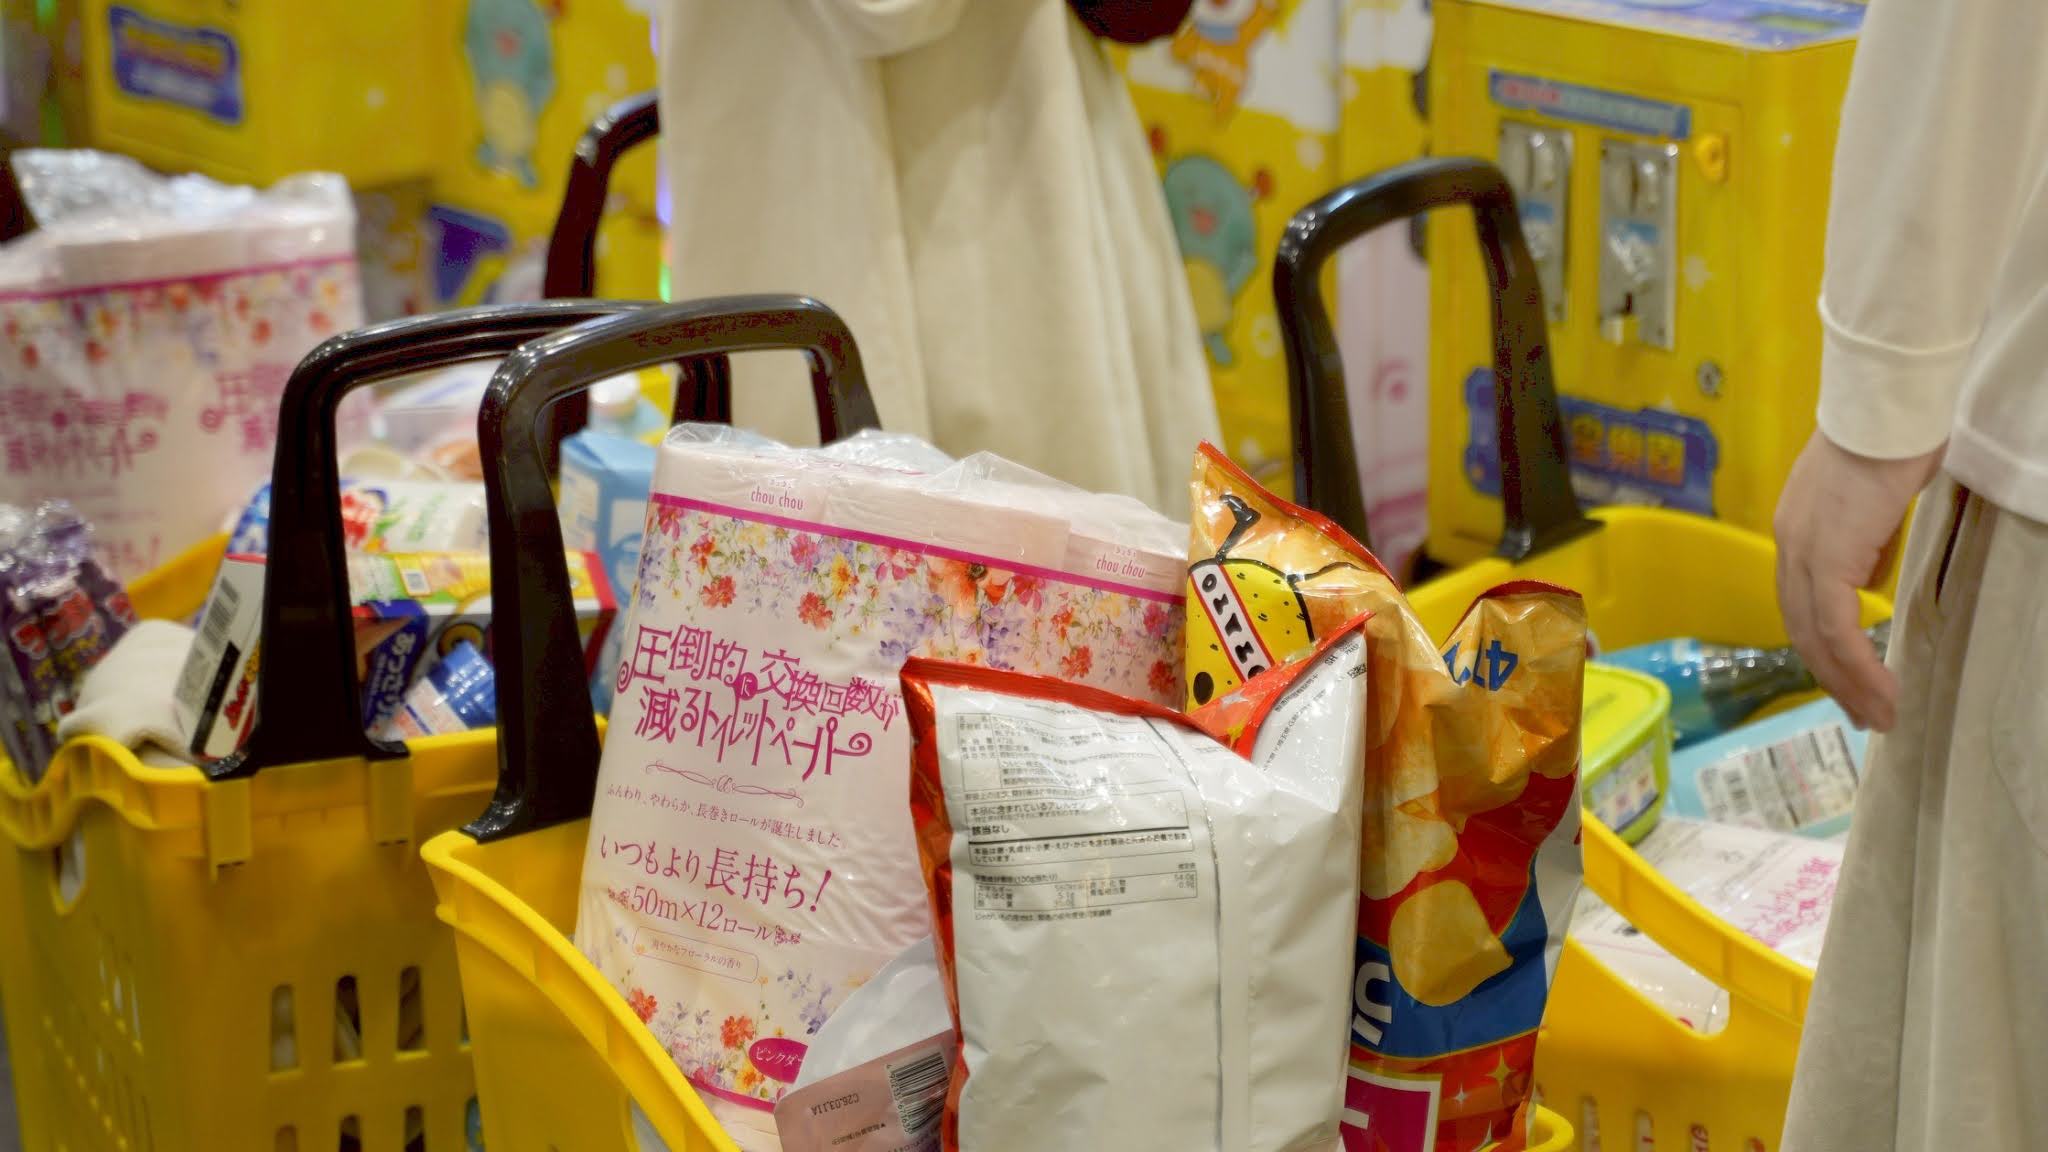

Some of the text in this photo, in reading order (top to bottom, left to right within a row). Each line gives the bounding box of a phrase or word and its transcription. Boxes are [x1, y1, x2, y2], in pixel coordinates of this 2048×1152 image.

[751, 485, 804, 511] chou chou
[1096, 553, 1146, 578] chou chou
[630, 885, 773, 942] 50m×12ロール
